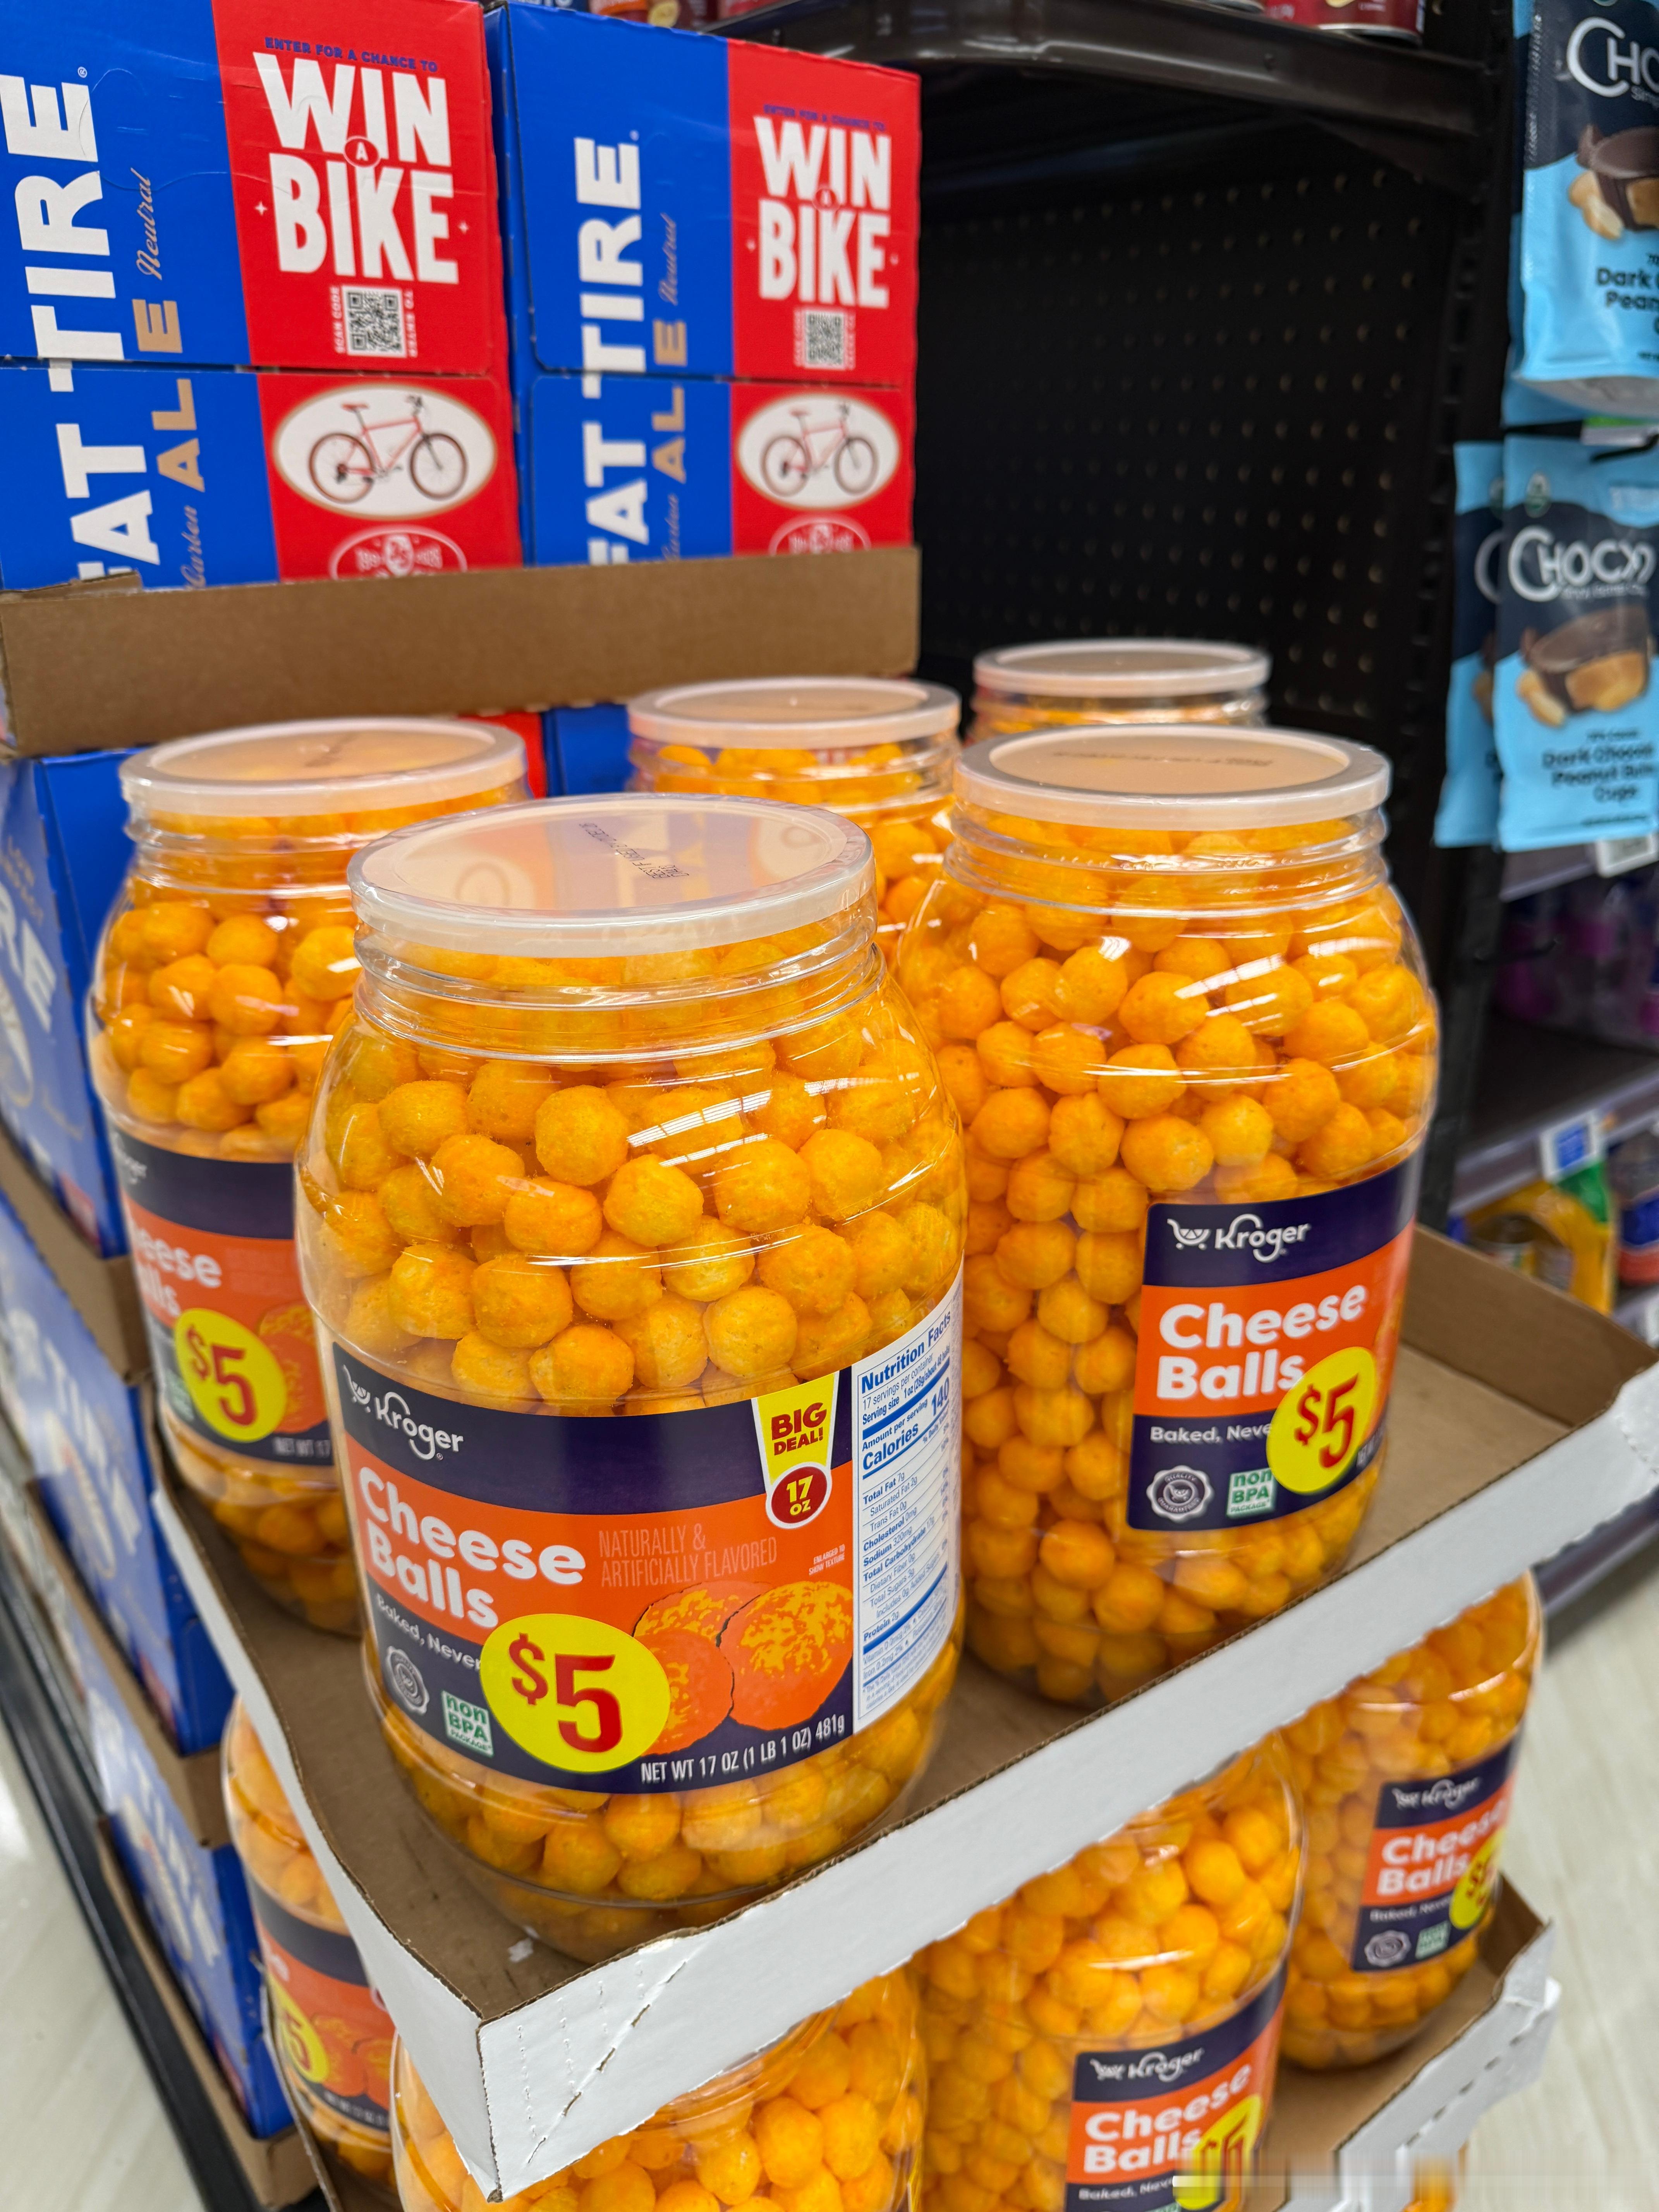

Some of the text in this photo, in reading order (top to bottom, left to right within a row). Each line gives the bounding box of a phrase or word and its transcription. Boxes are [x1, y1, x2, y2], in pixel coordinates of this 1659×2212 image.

[265, 37, 438, 72] ENTER FOR A CHANCE TO
[252, 52, 452, 167] WIN
[356, 142, 368, 161] A
[753, 115, 891, 211] WIN
[268, 152, 459, 284] BIKE
[575, 137, 646, 399] TIRE
[758, 198, 890, 309] BIKE
[1596, 267, 1651, 289] Dark
[133, 299, 205, 492] ALE
[651, 318, 688, 484] ALE
[1214, 1214, 1312, 1263] Kroger
[1159, 1285, 1367, 1349] Cheese
[186, 1323, 258, 1427] $5
[861, 1310, 951, 1394] Nutrition Facts
[1156, 1348, 1305, 1400] Balls
[862, 1405, 887, 1425] Serving
[888, 1396, 899, 1410] size
[907, 1386, 914, 1396] oz
[863, 1353, 933, 1410] 17 servings per container
[374, 1391, 464, 1460] Kroger
[771, 1402, 827, 1441] BIG
[774, 1427, 824, 1456] DEAL!
[862, 1428, 892, 1451] Amount
[894, 1419, 905, 1434] per
[907, 1398, 928, 1422] serving
[863, 1376, 950, 1470] Calories 140
[1151, 1423, 1272, 1444] Baked, Neve
[1294, 1373, 1359, 1468] $5
[787, 1475, 814, 1503] 17
[790, 1499, 811, 1516] OZ
[863, 1472, 905, 1505] Total Fat 7g
[870, 1489, 900, 1516] Saturated
[901, 1482, 910, 1495] Fat
[1232, 1485, 1269, 1503] BPA
[359, 1467, 586, 1585] Cheese
[598, 1523, 706, 1558] NATURALLY &
[863, 1516, 905, 1551] Cholesterol
[870, 1516, 888, 1532] Trans
[889, 1507, 899, 1520] Fat
[601, 1536, 778, 1588] ARTIFICIALLY FLAVORED
[863, 1526, 912, 1567] Sodium 320mg
[863, 1562, 883, 1582] Total
[884, 1527, 926, 1568] Carbohydrate
[366, 1518, 499, 1628] Balls
[870, 1573, 892, 1593] Dietary
[870, 1590, 886, 1607] Total
[863, 1618, 890, 1642] Protein
[446, 1695, 487, 1725] non
[508, 1632, 623, 1753] $5
[448, 1714, 489, 1743] BPA
[641, 1714, 845, 1784] NET WT 17 OZ (1 LB 1 OZ) 481g
[1376, 1852, 1470, 1897] Balls
[1128, 2047, 1205, 2082] Kroger
[1085, 2064, 1251, 2141] Cheese
